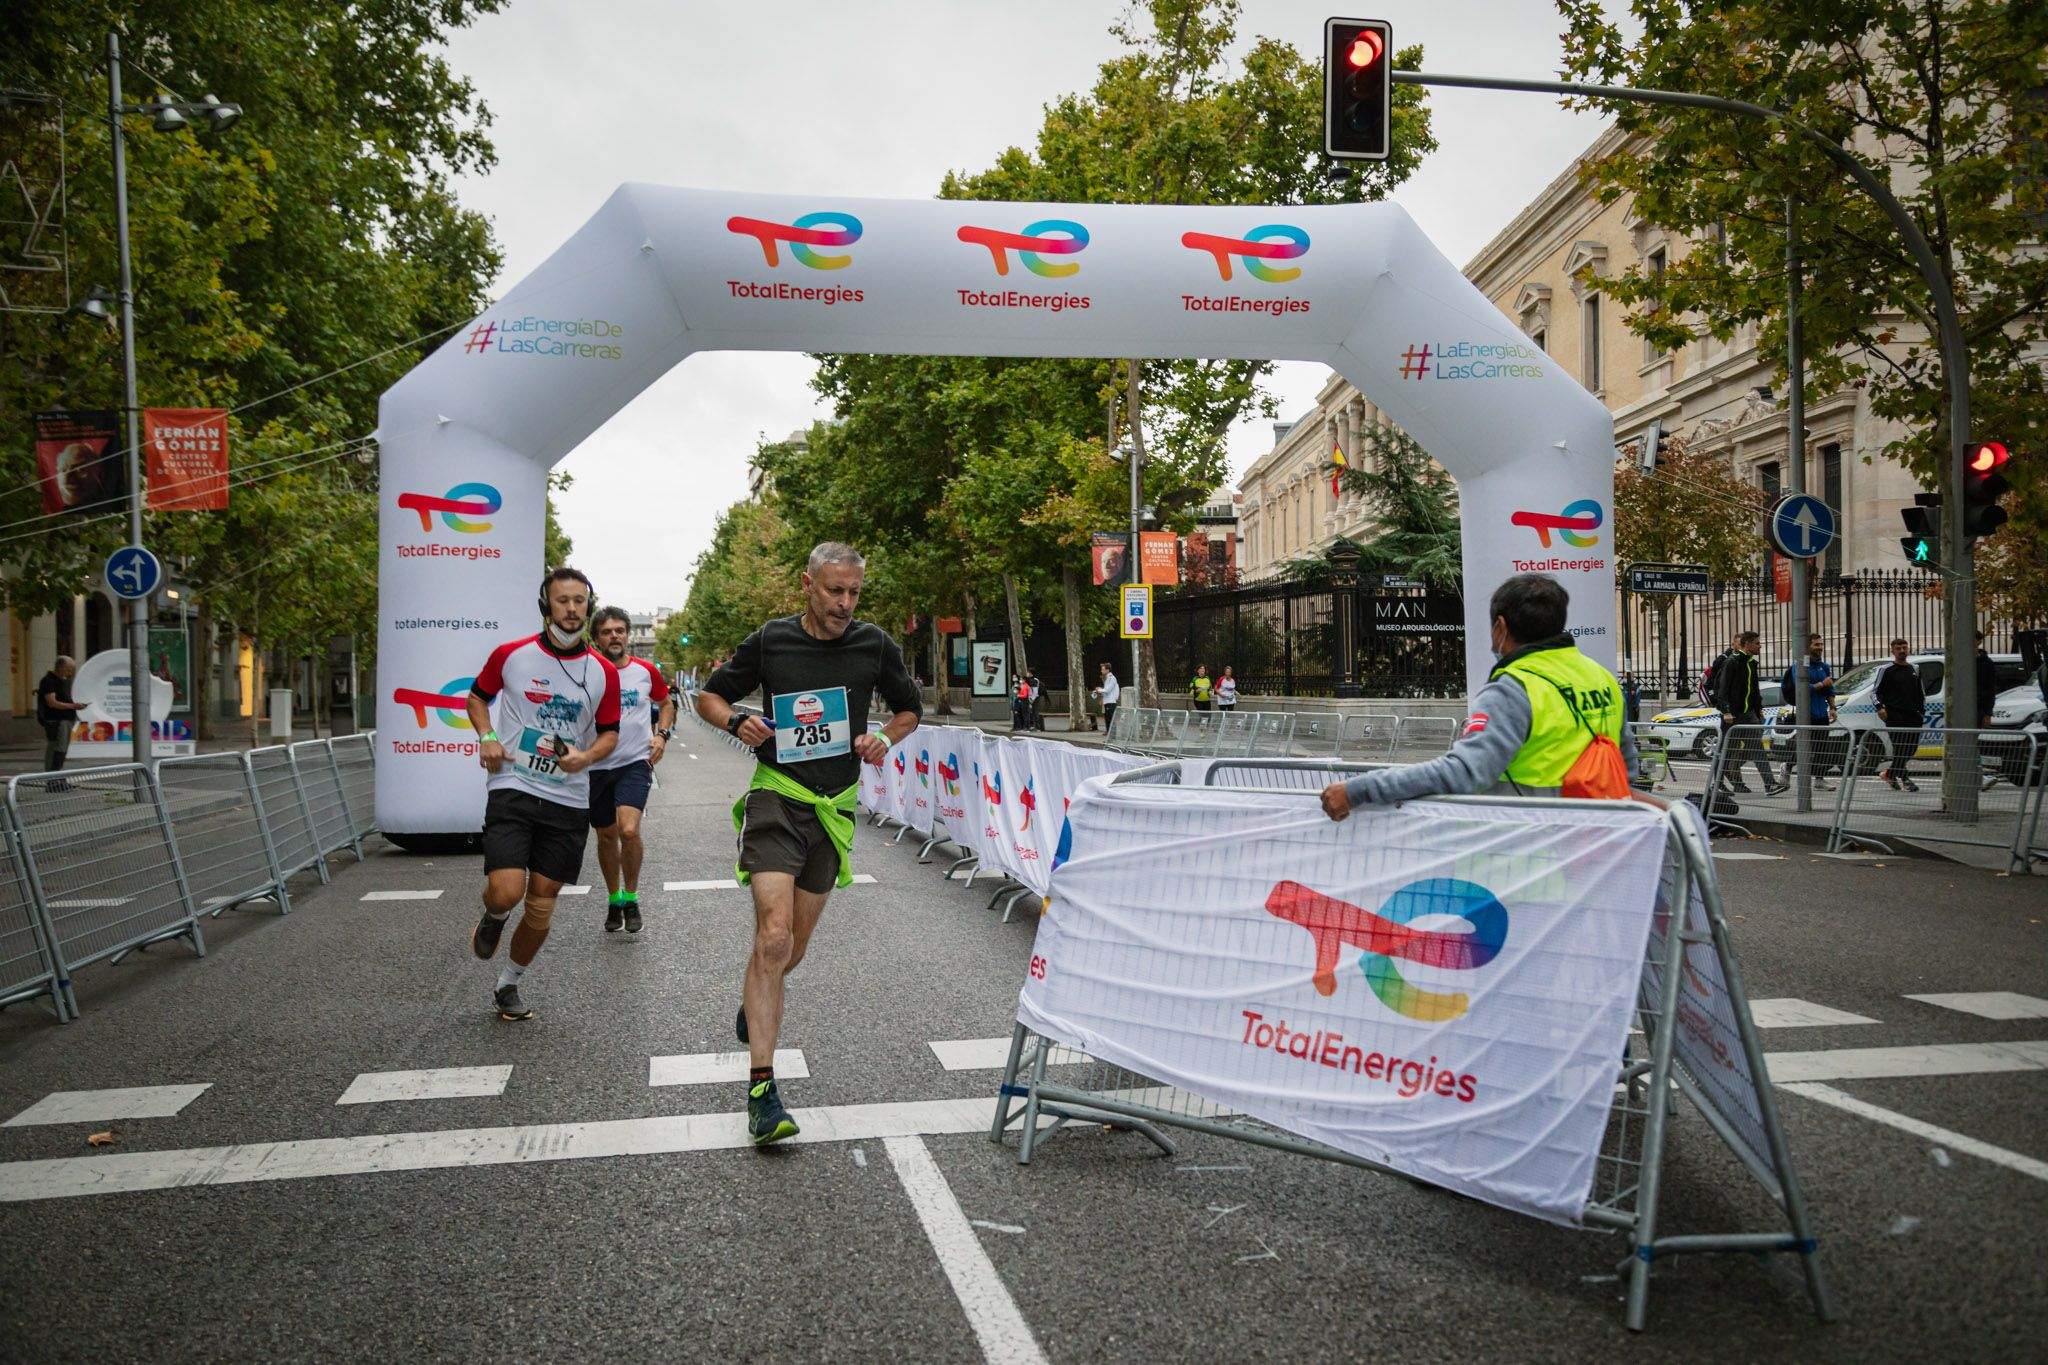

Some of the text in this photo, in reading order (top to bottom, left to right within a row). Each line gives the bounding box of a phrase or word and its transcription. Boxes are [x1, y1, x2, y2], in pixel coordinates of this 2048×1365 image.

[727, 281, 864, 305] TotalEnergies
[957, 290, 1090, 312] TotalEnergies
[1181, 296, 1310, 316] TotalEnergies
[499, 336, 622, 359] LasCarreras
[1436, 361, 1544, 380] LasCarreras
[397, 543, 501, 560] TotalEnergies
[1512, 556, 1604, 572] TotalEnergies
[1644, 581, 1707, 592] LA ARMADA ESPAÑOLA
[395, 617, 499, 630] totalenergies.es
[1401, 623, 1455, 632] ARQUEOLÓGICO
[794, 724, 831, 747] 235
[528, 755, 559, 775] 1157
[1242, 1010, 1477, 1103] TotalEnergies
